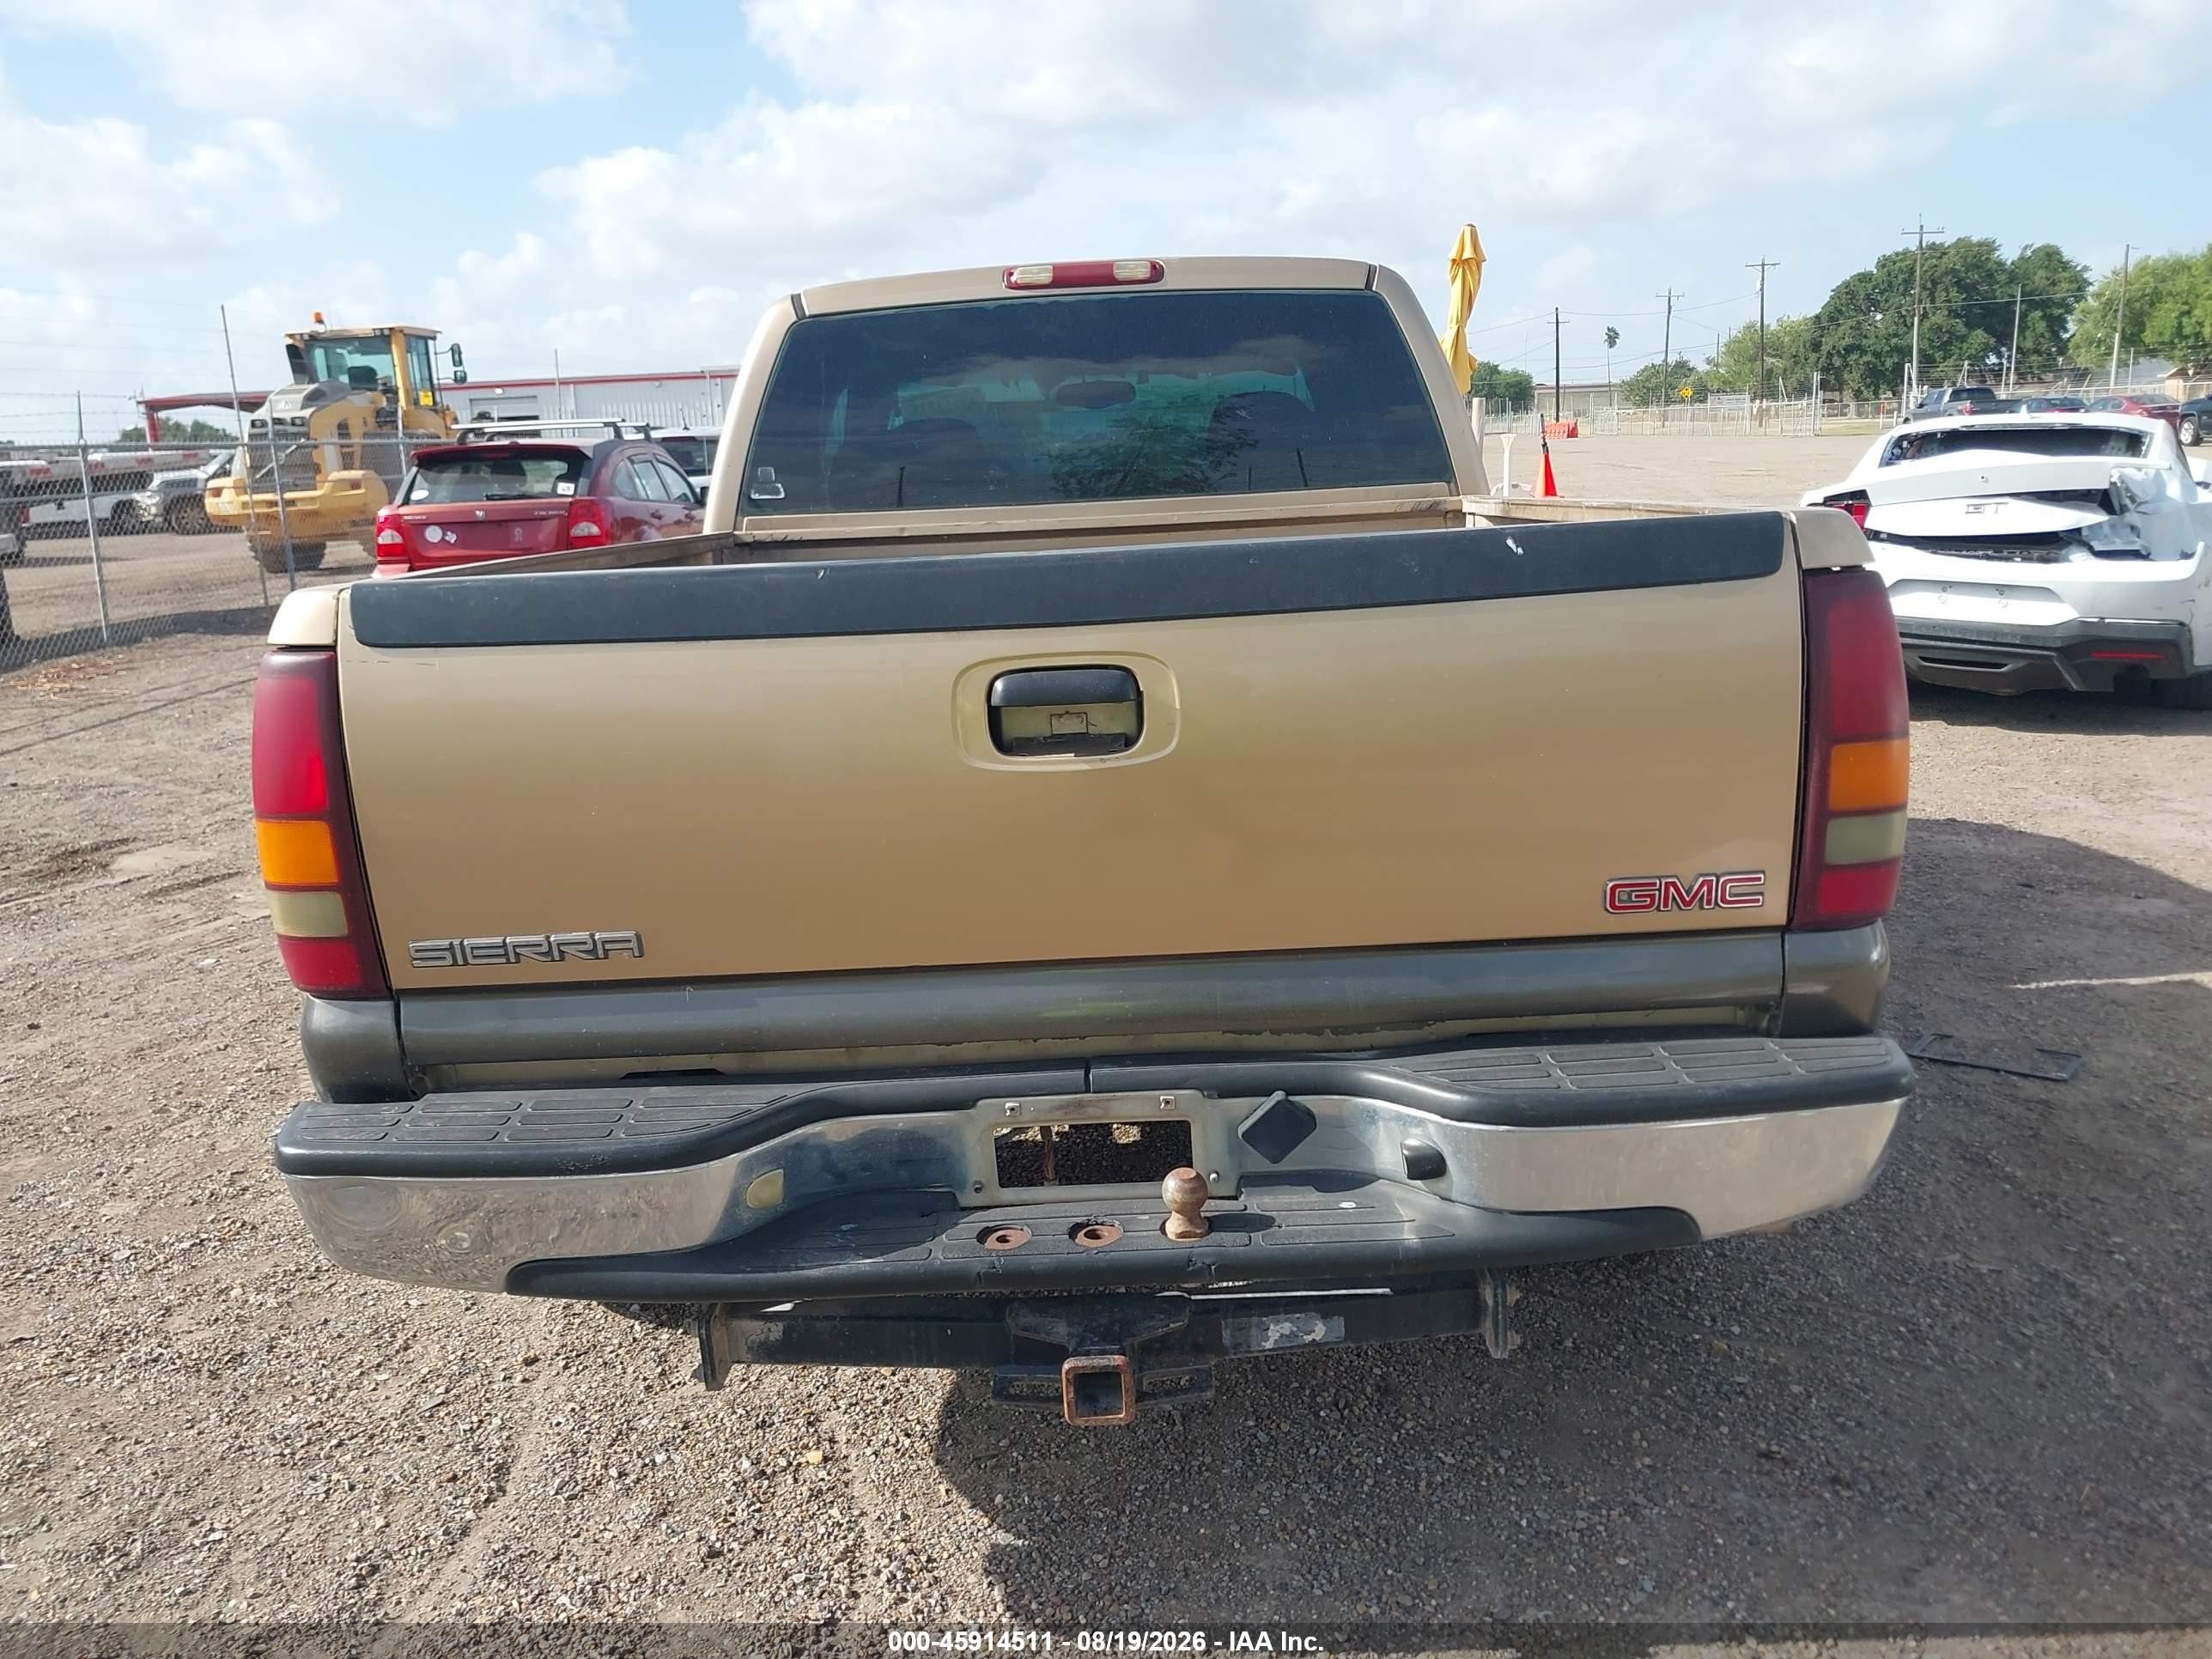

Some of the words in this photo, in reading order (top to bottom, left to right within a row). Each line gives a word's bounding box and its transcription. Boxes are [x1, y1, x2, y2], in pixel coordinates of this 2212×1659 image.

[1965, 501, 2009, 515] GT
[1605, 871, 1765, 914] GMC
[409, 931, 644, 967] SIERRA
